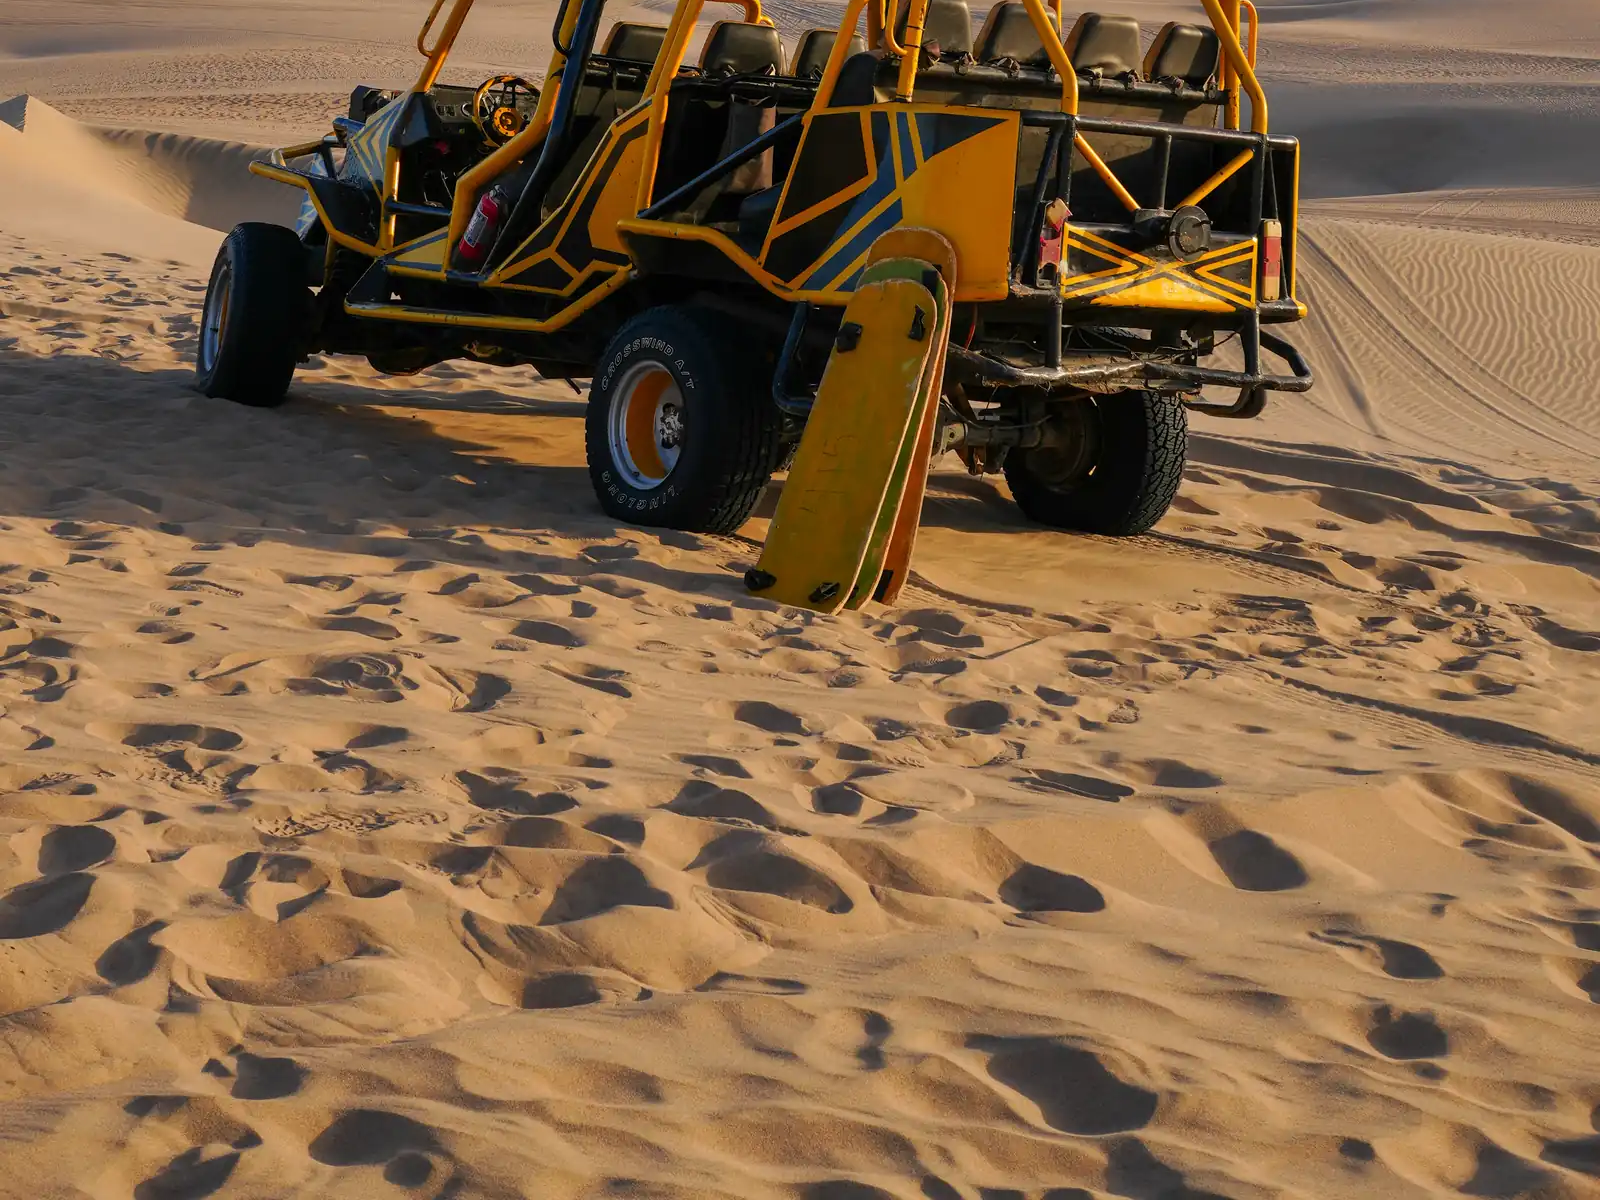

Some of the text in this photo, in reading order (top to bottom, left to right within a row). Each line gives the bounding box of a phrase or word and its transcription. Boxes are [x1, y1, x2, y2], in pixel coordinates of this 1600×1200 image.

[601, 337, 695, 390] CROSSWIND A/T
[602, 470, 677, 510] LINGLONG
